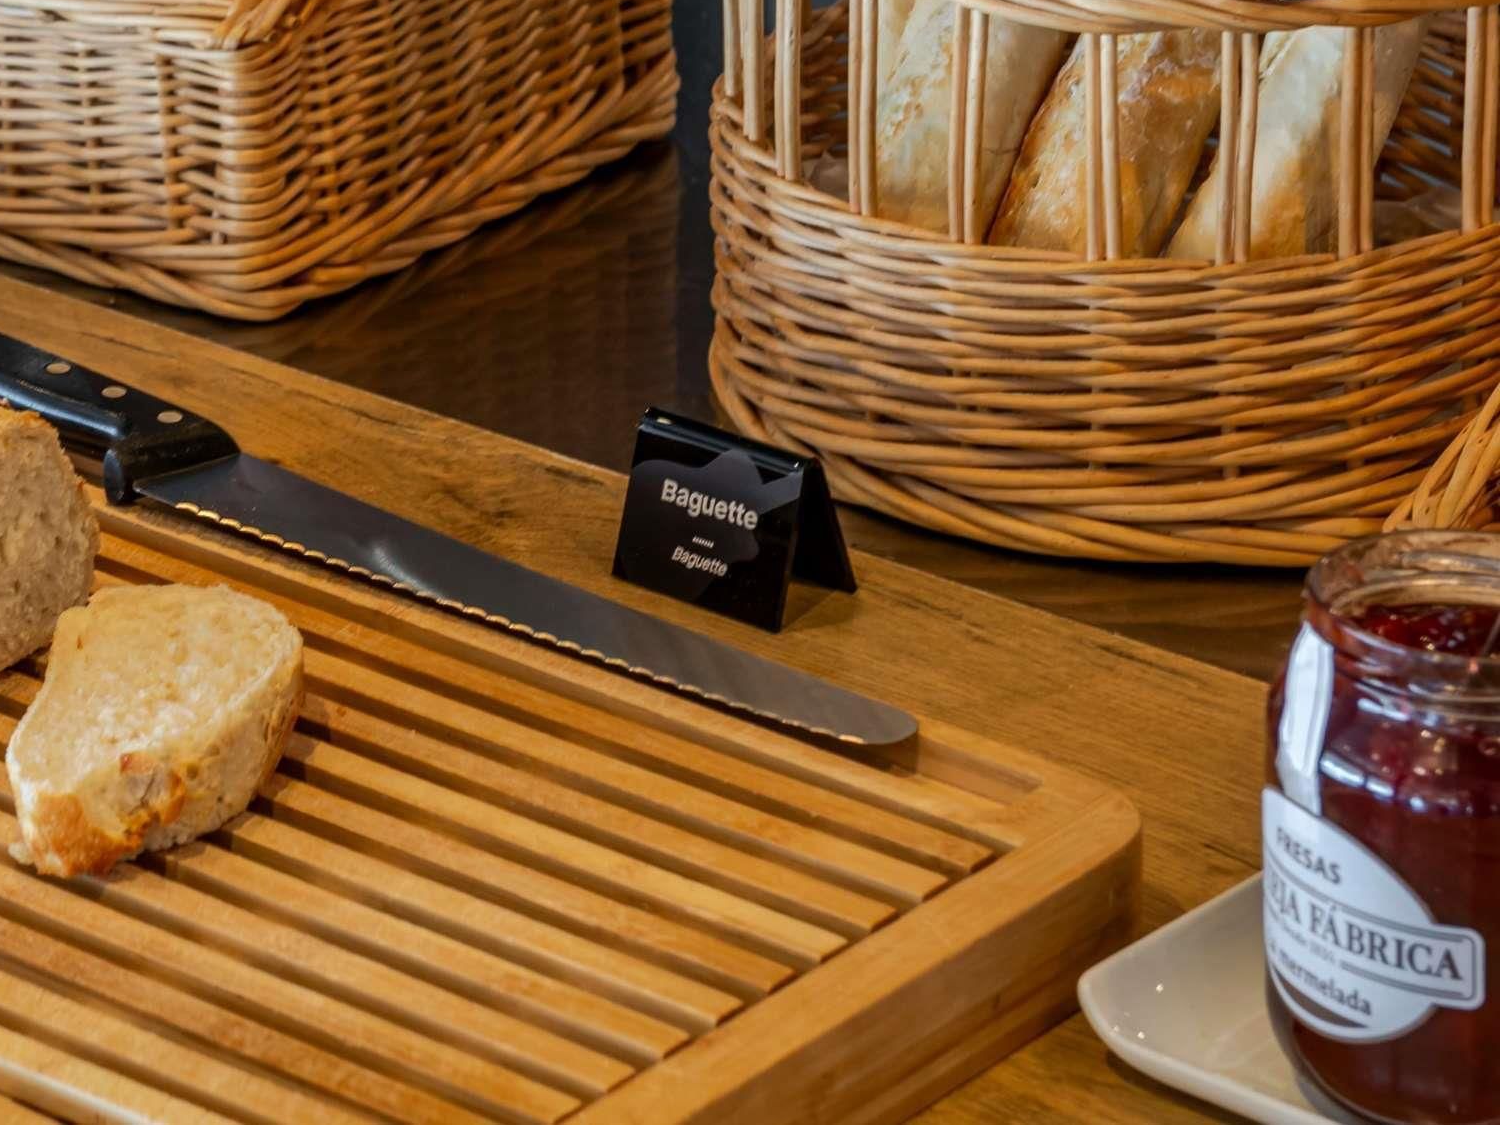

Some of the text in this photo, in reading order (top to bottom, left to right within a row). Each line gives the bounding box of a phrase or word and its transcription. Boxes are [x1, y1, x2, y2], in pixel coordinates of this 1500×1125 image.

[660, 477, 759, 531] Baguette
[671, 545, 729, 577] Baguette
[1275, 826, 1342, 885] FRESAS
[1308, 901, 1464, 982] FÁBRICA
